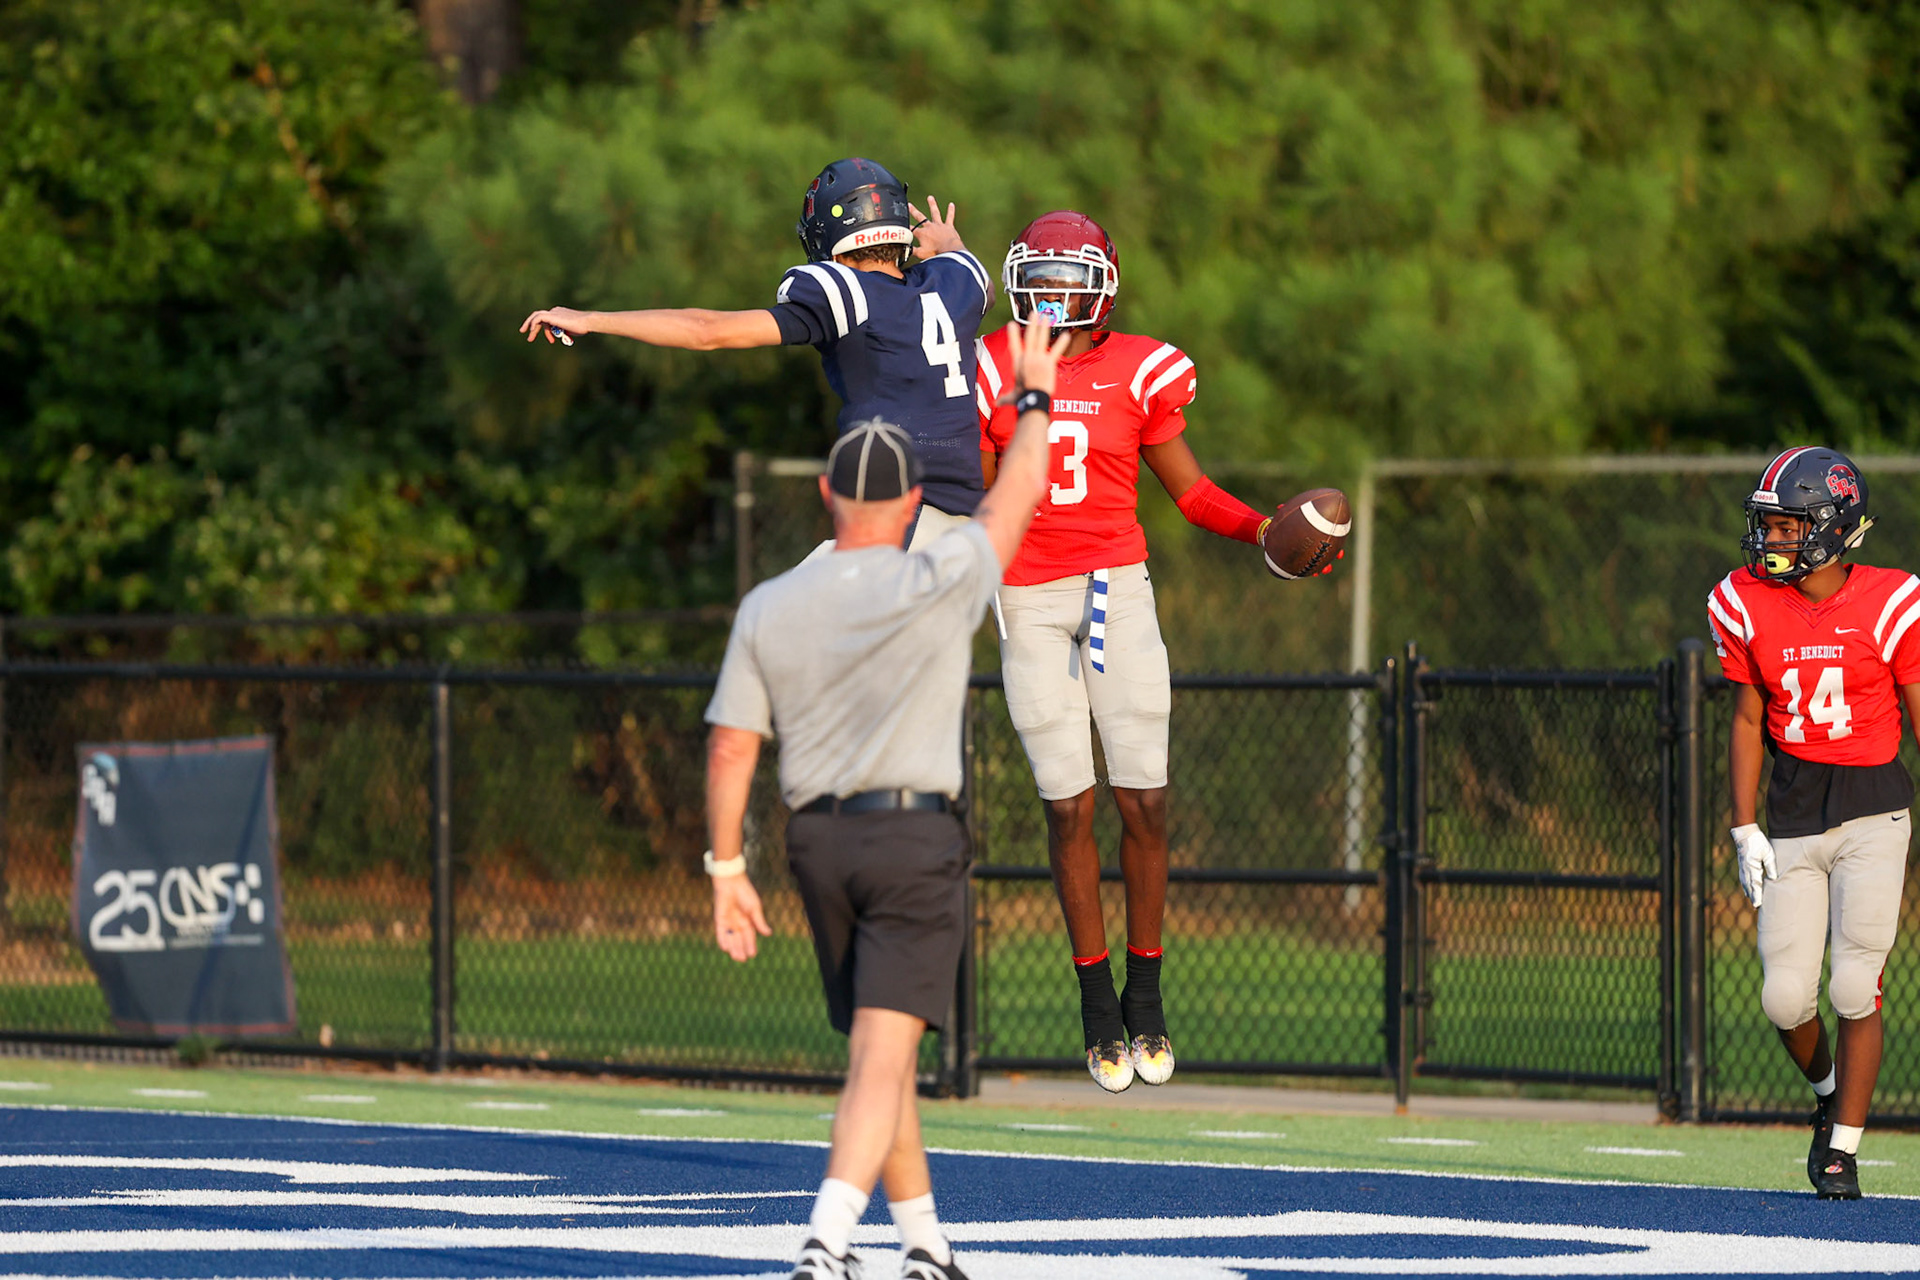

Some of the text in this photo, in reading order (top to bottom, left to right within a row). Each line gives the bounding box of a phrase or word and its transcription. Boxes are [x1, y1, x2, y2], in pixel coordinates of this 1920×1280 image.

[919, 292, 970, 399] 4
[1053, 399, 1101, 415] BENEDICT
[1047, 420, 1089, 505] 3
[1782, 645, 1844, 662] ST. BENEDICT
[1780, 667, 1853, 743] 14
[89, 869, 165, 952] 25
